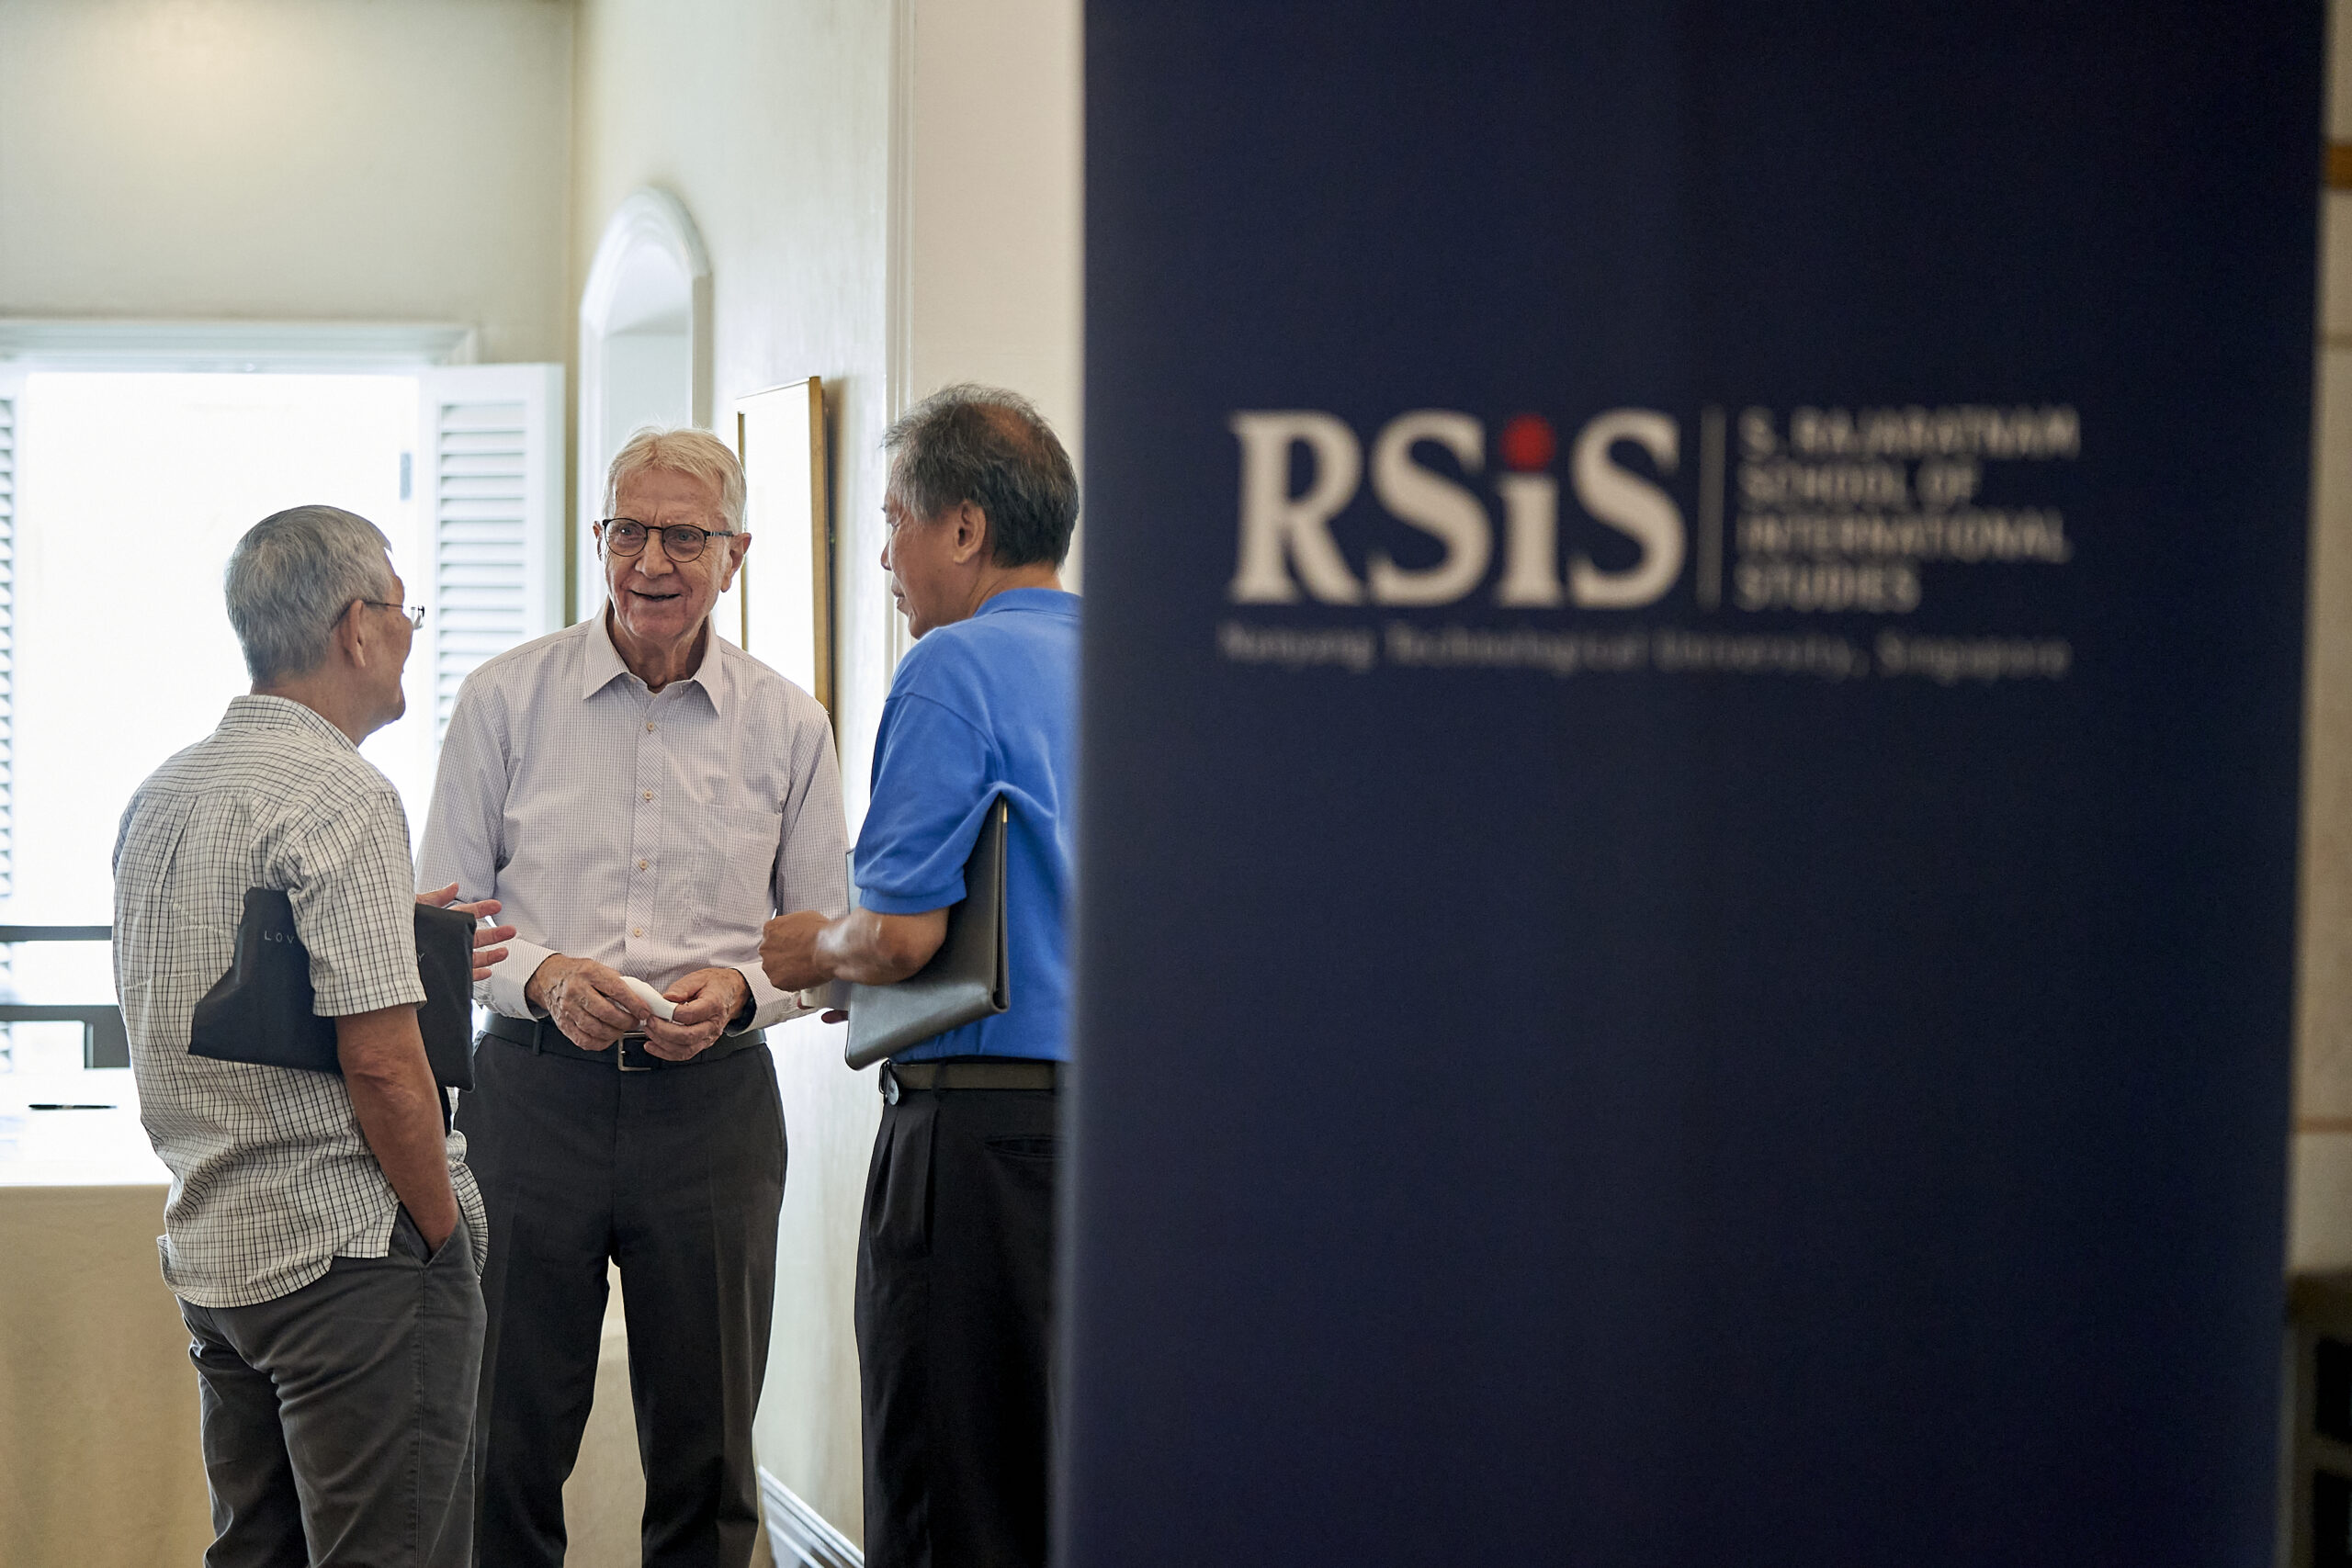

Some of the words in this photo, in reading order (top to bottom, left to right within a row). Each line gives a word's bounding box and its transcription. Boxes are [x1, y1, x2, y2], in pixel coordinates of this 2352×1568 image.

[1740, 460, 1907, 506] SCHOOL
[1918, 459, 1980, 505] OF
[1228, 408, 1687, 608] RSiS
[1738, 510, 2069, 559] INTERNATIONAL
[1736, 560, 1919, 611] STUDIES
